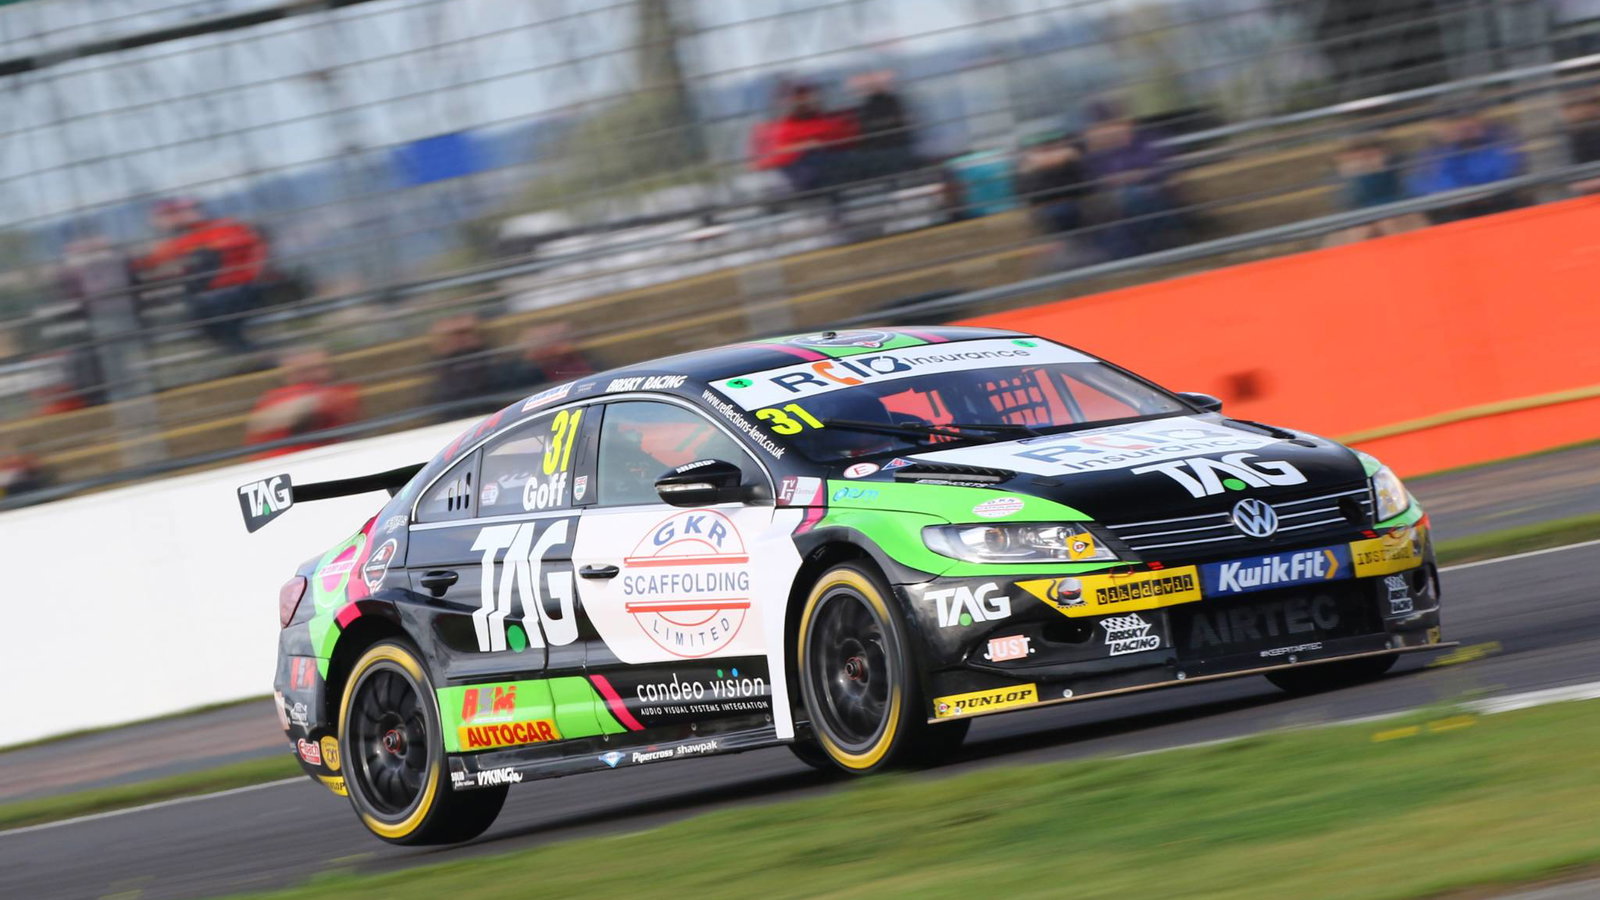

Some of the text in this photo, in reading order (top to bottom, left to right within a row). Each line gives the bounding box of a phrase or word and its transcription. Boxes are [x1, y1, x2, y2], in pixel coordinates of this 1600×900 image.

[902, 349, 1031, 366] Insurance
[605, 376, 643, 392] BRISKY
[643, 374, 689, 390] RACING
[701, 388, 786, 461] www.reflections-kent.co.uk
[755, 403, 825, 435] 31
[542, 408, 582, 475] 31
[1062, 437, 1266, 470] Insurance
[522, 471, 568, 511] Goff
[1130, 451, 1308, 499] TAG
[240, 475, 293, 518] TAG
[652, 513, 729, 549] GKR
[470, 518, 580, 653] TAG
[623, 571, 749, 595] SCAFFOLDING
[1218, 550, 1326, 593] KwikFit
[923, 582, 1012, 628] TAG
[1095, 573, 1195, 606] bikedevil
[652, 616, 730, 648] LIMITED
[1108, 625, 1149, 642] BRISKY
[1189, 595, 1340, 649] AIRTEC
[1113, 637, 1158, 654] RACING
[636, 667, 766, 702] candeo vision
[955, 689, 1033, 710] DUNLOP
[640, 700, 769, 716] AUDIO VISUAL SYSTEMS INTEGRATION
[467, 720, 556, 748] AUTOCAR
[631, 740, 718, 764] Pipercross shawpak
